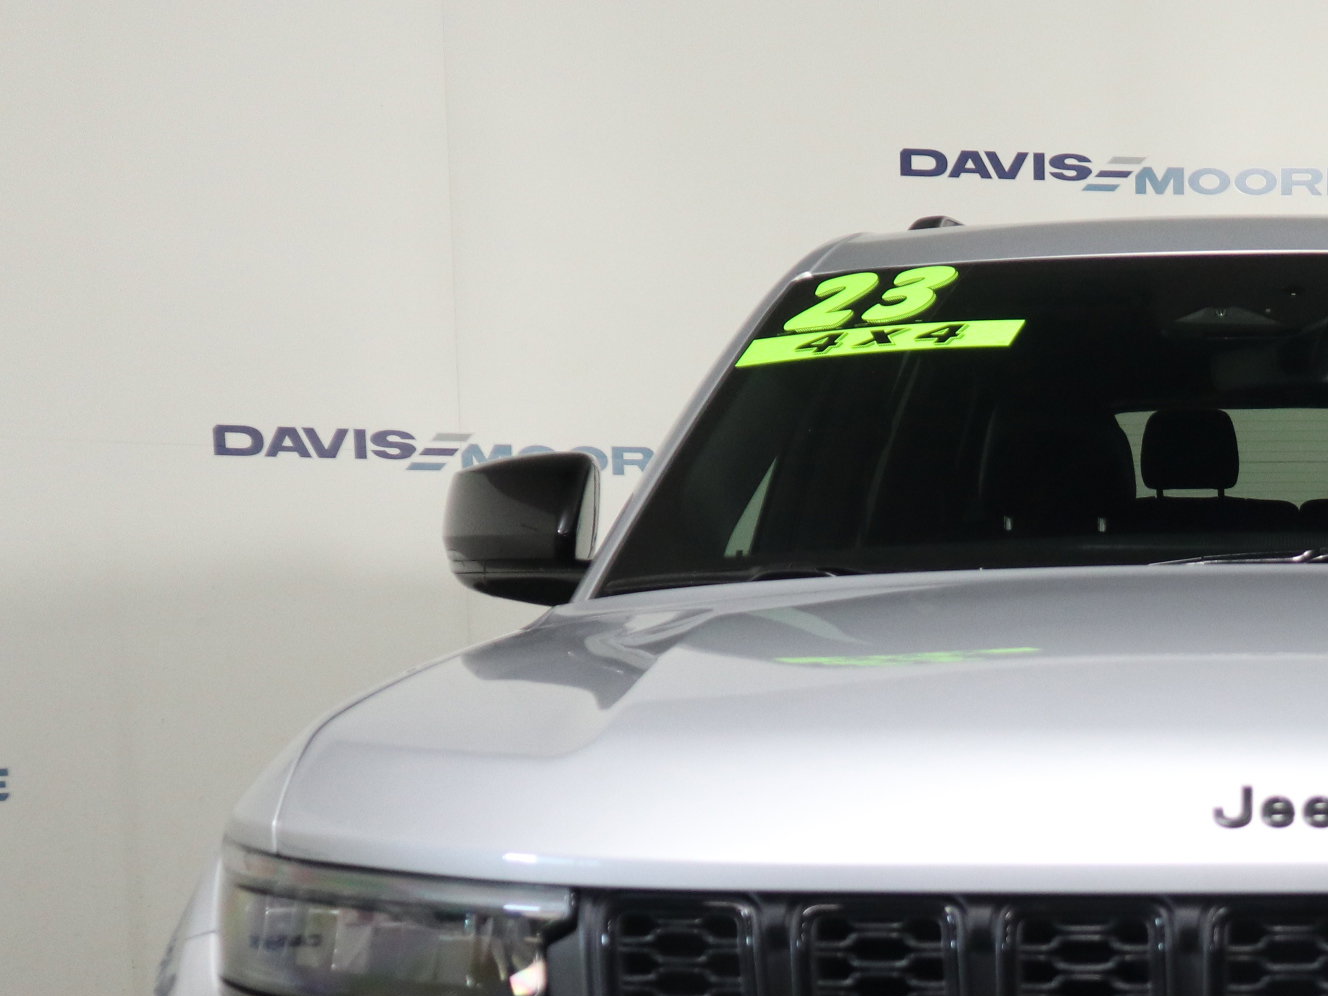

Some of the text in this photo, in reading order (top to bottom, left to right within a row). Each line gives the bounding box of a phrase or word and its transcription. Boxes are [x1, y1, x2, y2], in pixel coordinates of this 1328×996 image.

[899, 147, 1093, 182] DAVIS
[782, 265, 959, 333] 23
[212, 424, 417, 460] DAVIS
